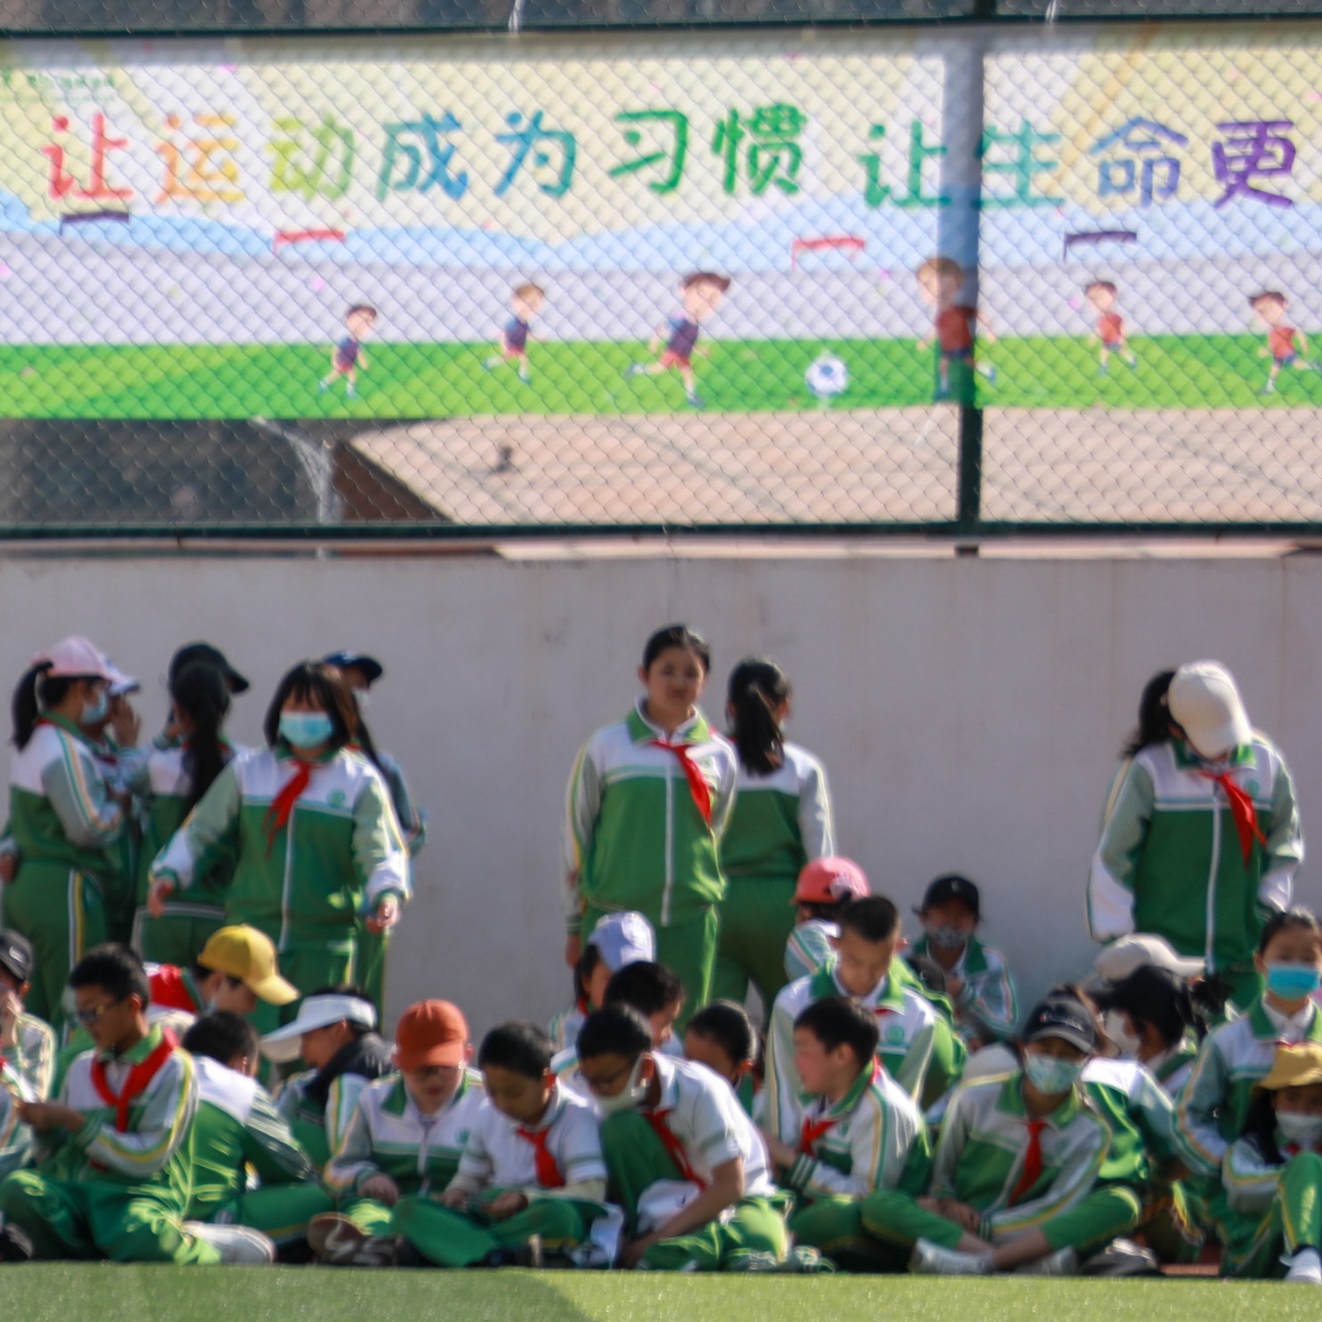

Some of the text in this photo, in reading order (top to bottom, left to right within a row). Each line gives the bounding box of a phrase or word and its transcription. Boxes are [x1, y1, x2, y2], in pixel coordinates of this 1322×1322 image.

[42, 103, 1298, 209] 让运动成为习惯 让生命更
